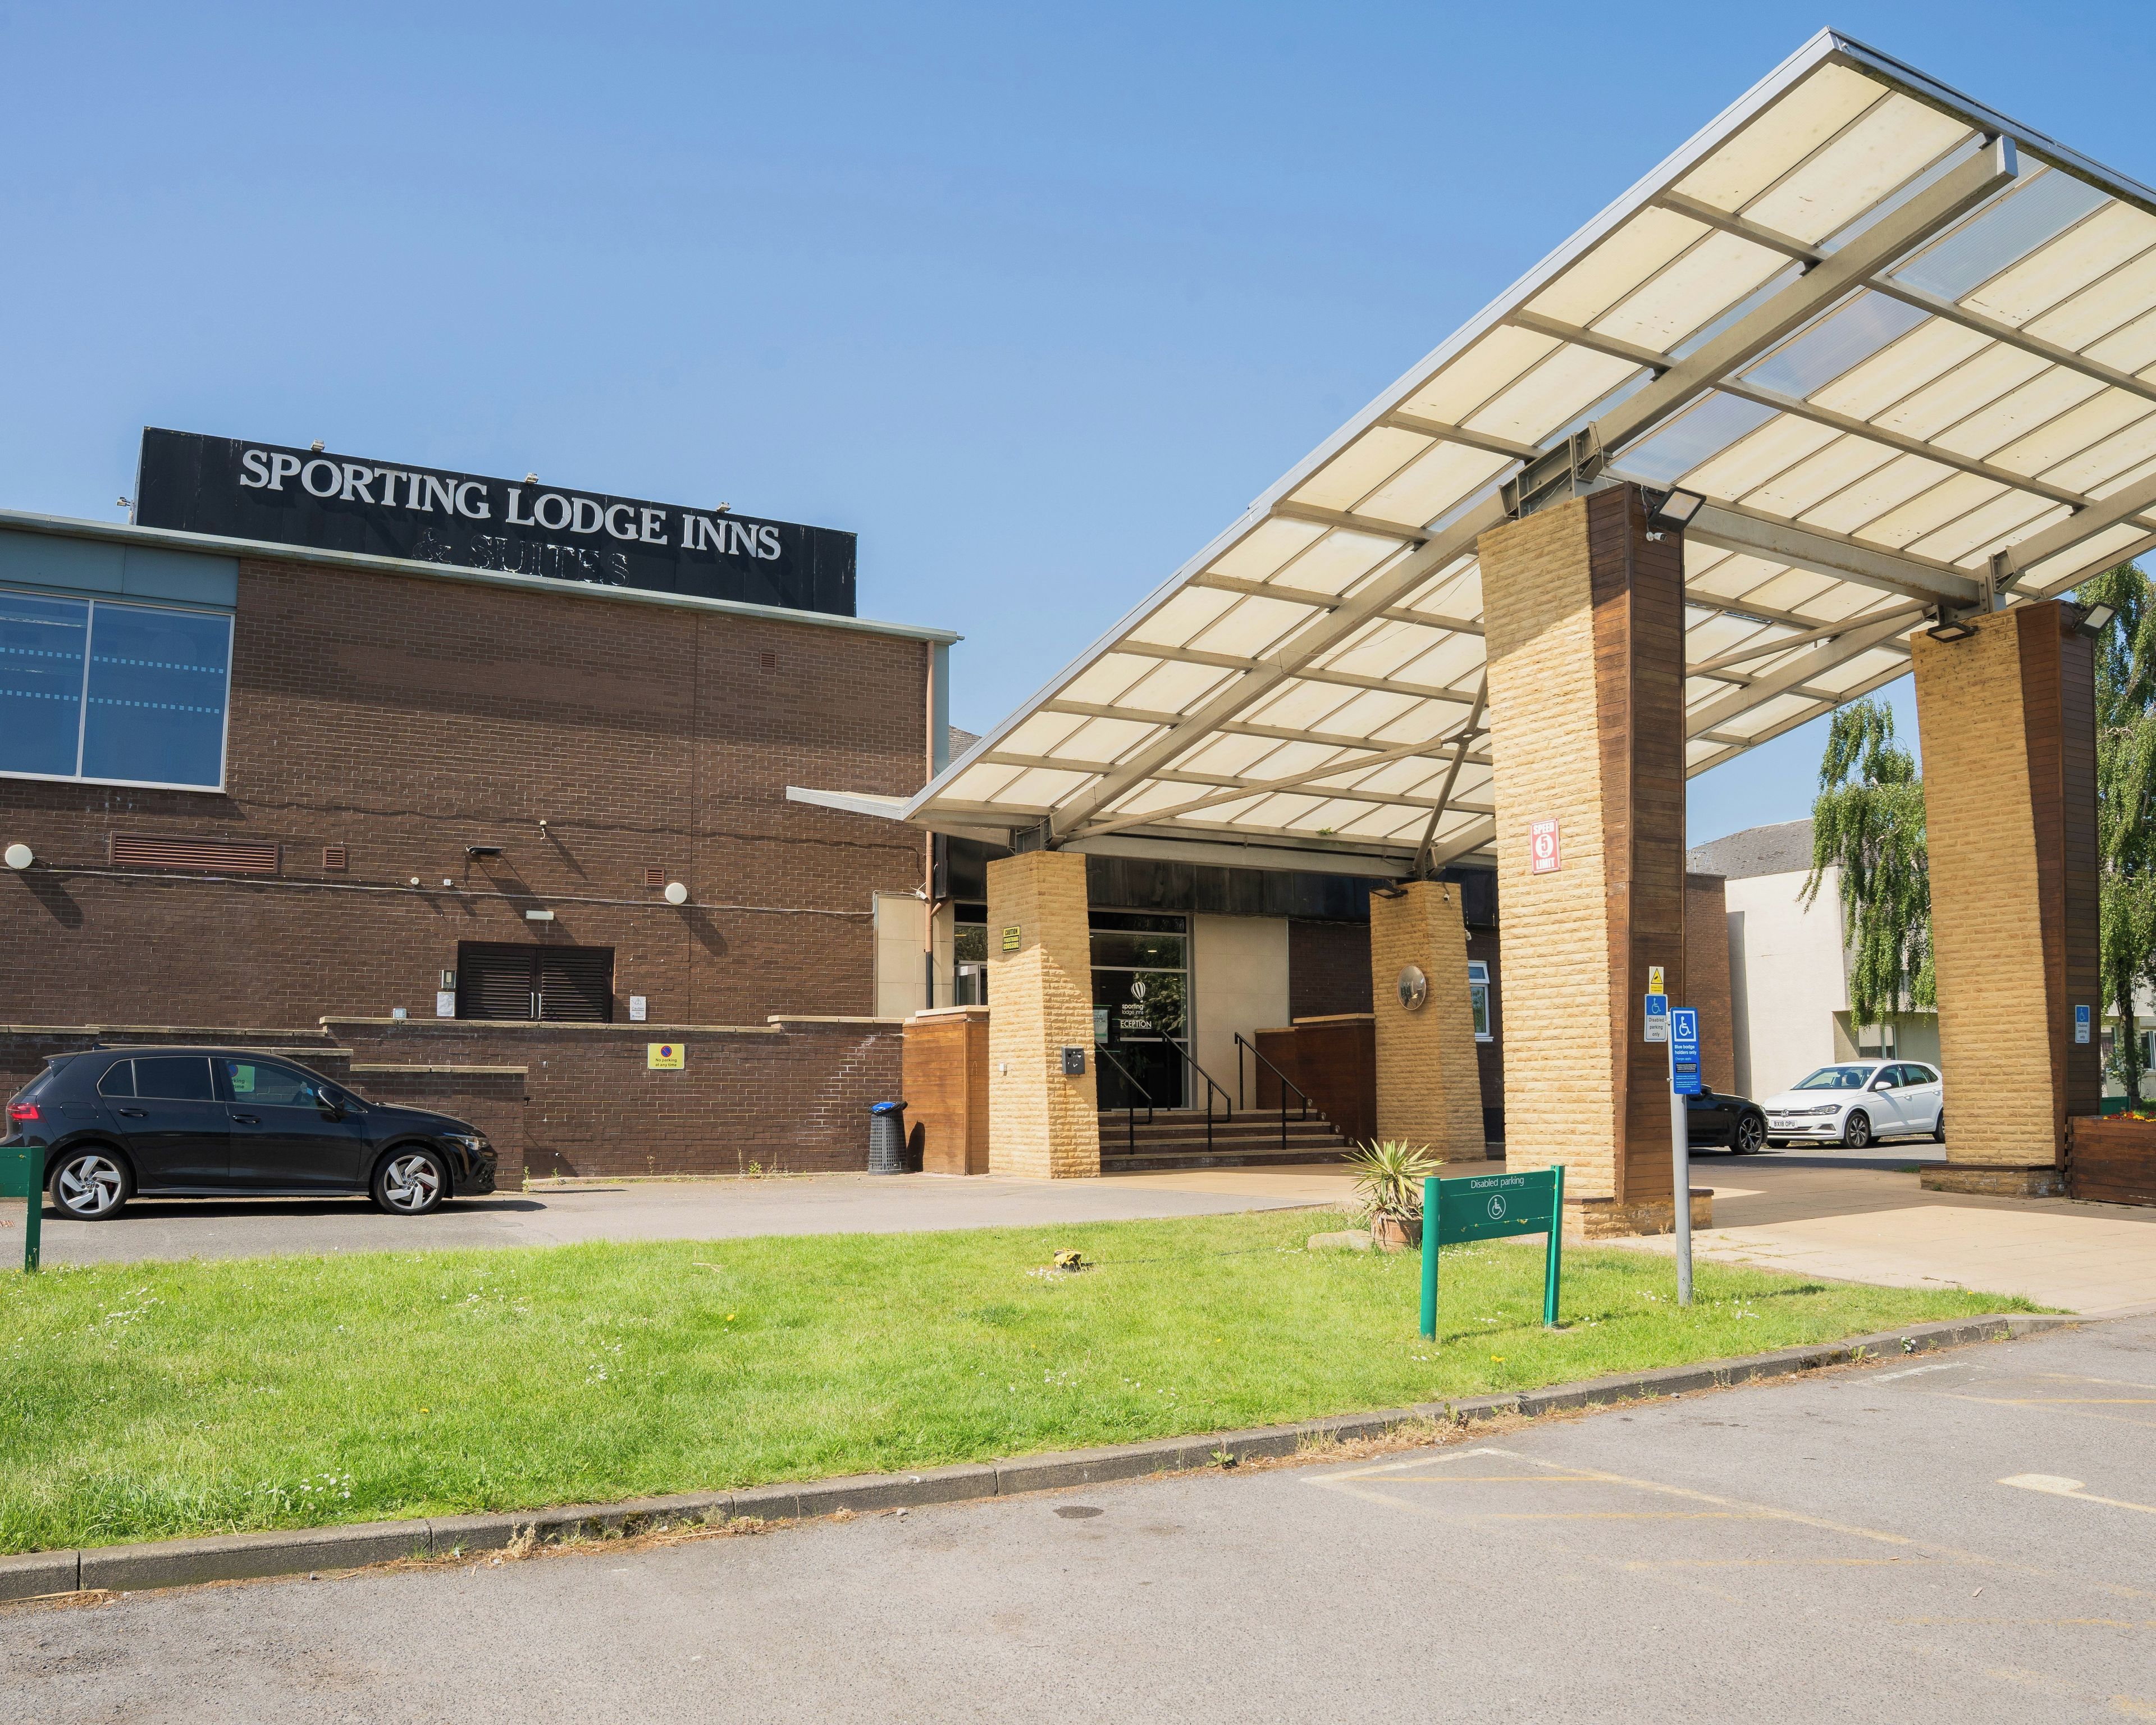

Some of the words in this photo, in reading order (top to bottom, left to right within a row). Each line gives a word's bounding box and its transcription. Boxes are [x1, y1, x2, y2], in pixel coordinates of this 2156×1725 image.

[240, 449, 491, 519] SPORTING
[506, 488, 668, 545] LODGE
[681, 514, 781, 560] INNS
[1533, 822, 1554, 836] SPEED
[1541, 836, 1548, 851] 5
[1536, 857, 1555, 870] LIMIT
[1003, 941, 1019, 950] CROSSING
[1471, 1178, 1499, 1189] Disabled
[1500, 1176, 1524, 1188] parking
